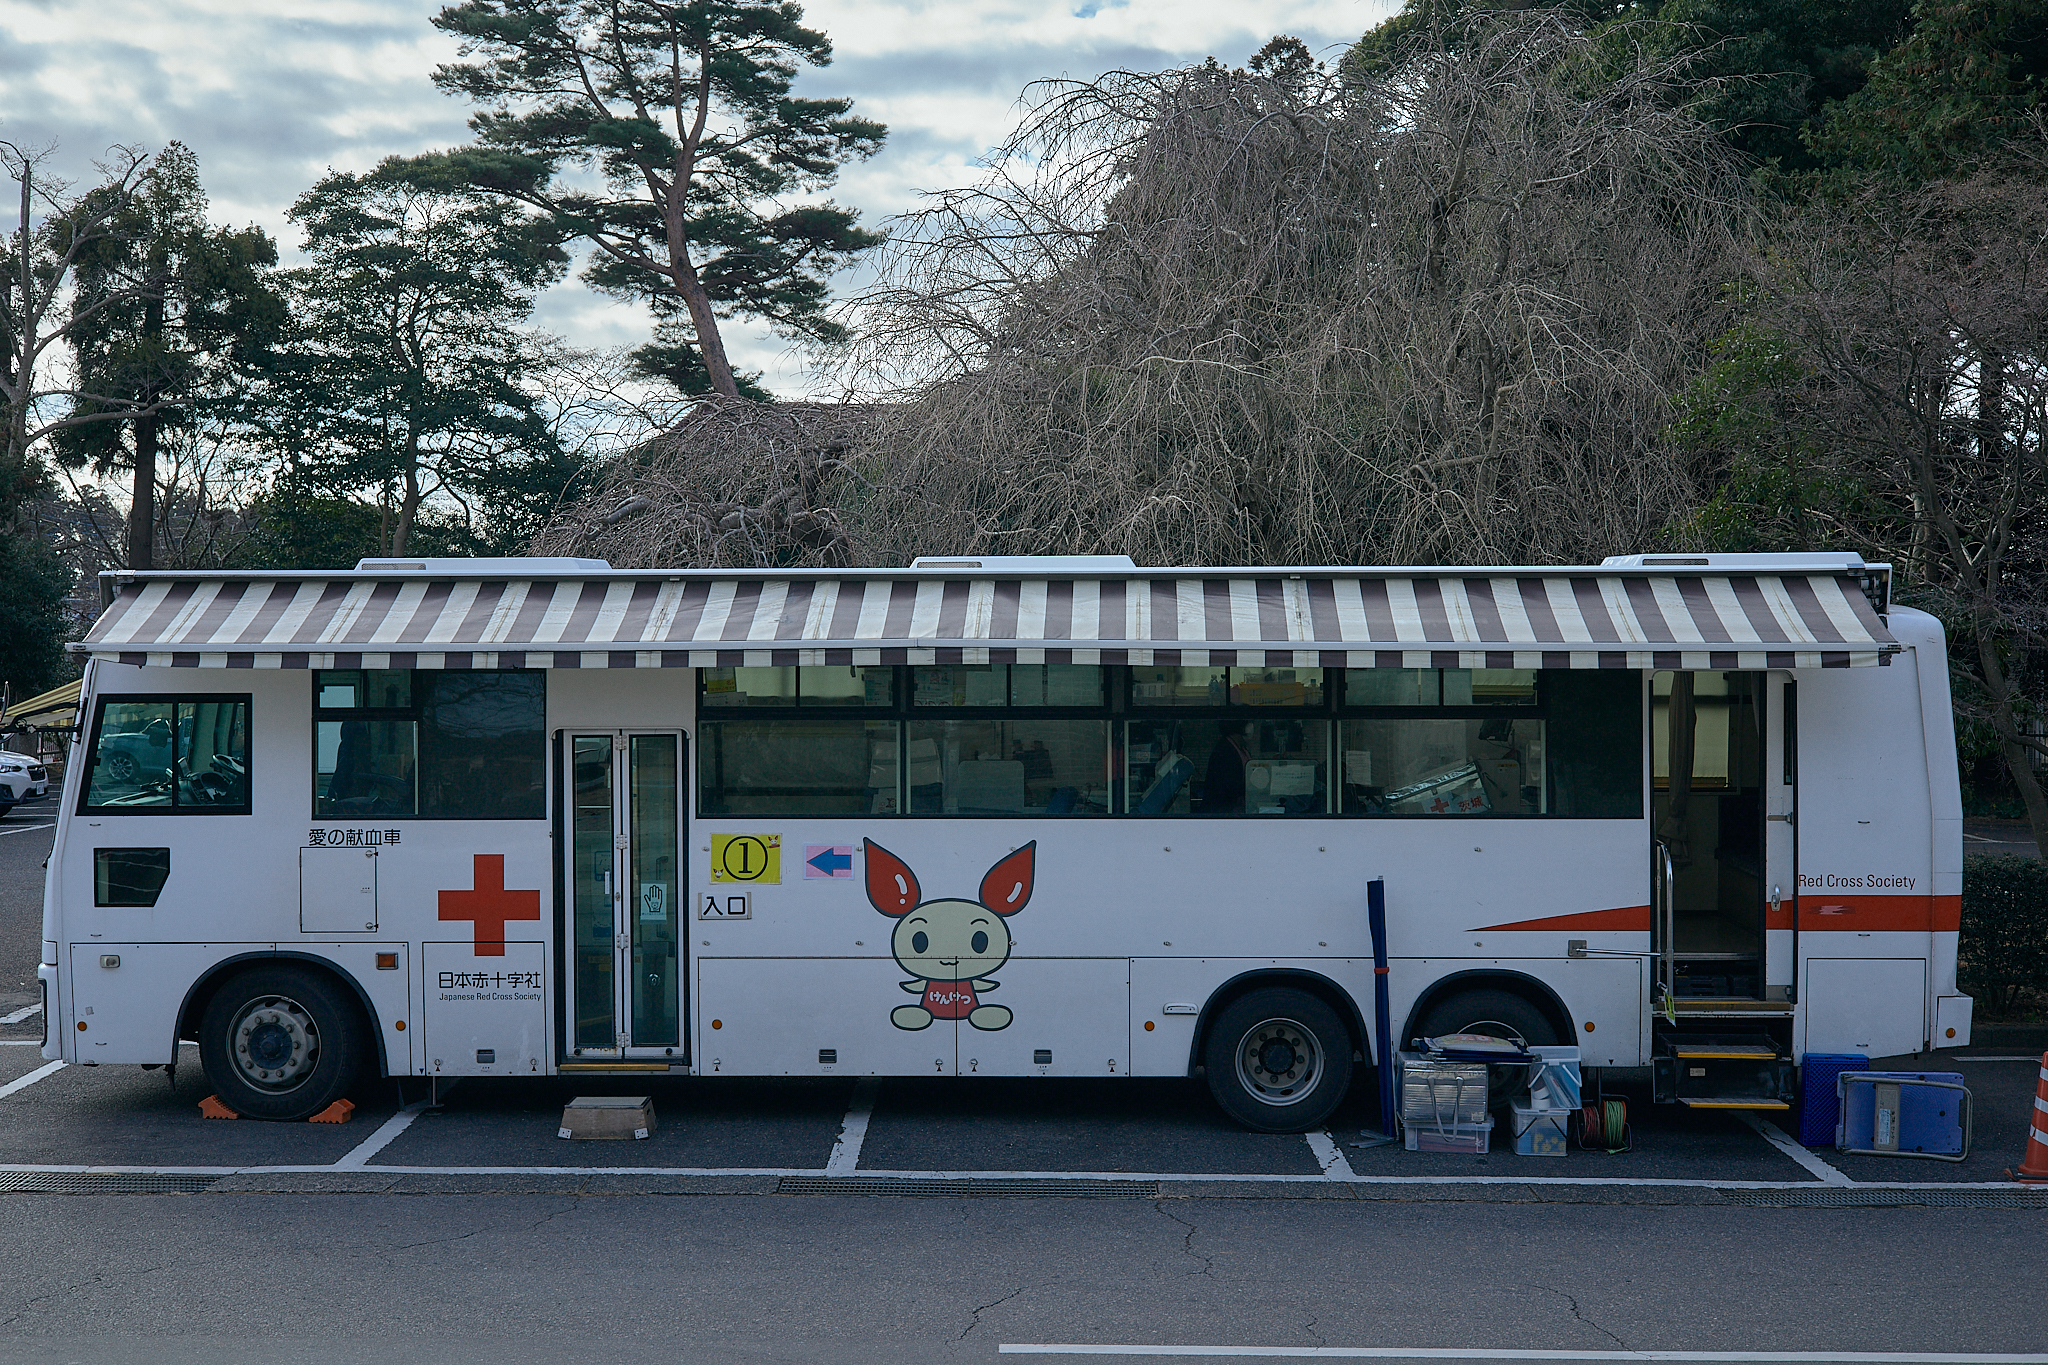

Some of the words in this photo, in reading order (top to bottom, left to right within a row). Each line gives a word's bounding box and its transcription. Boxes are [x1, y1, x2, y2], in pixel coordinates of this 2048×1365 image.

[309, 828, 402, 847] 愛の献血車
[1798, 874, 1823, 888] Red
[1827, 874, 1863, 888] Cross
[1866, 874, 1916, 891] Society
[703, 896, 746, 916] 入口
[439, 971, 541, 989] 日本赤十字社
[439, 992, 475, 1002] Japanese
[476, 992, 491, 1001] Red
[492, 992, 513, 1001] Cross
[514, 992, 542, 1002] Society
[929, 991, 972, 1005] けんけつ
